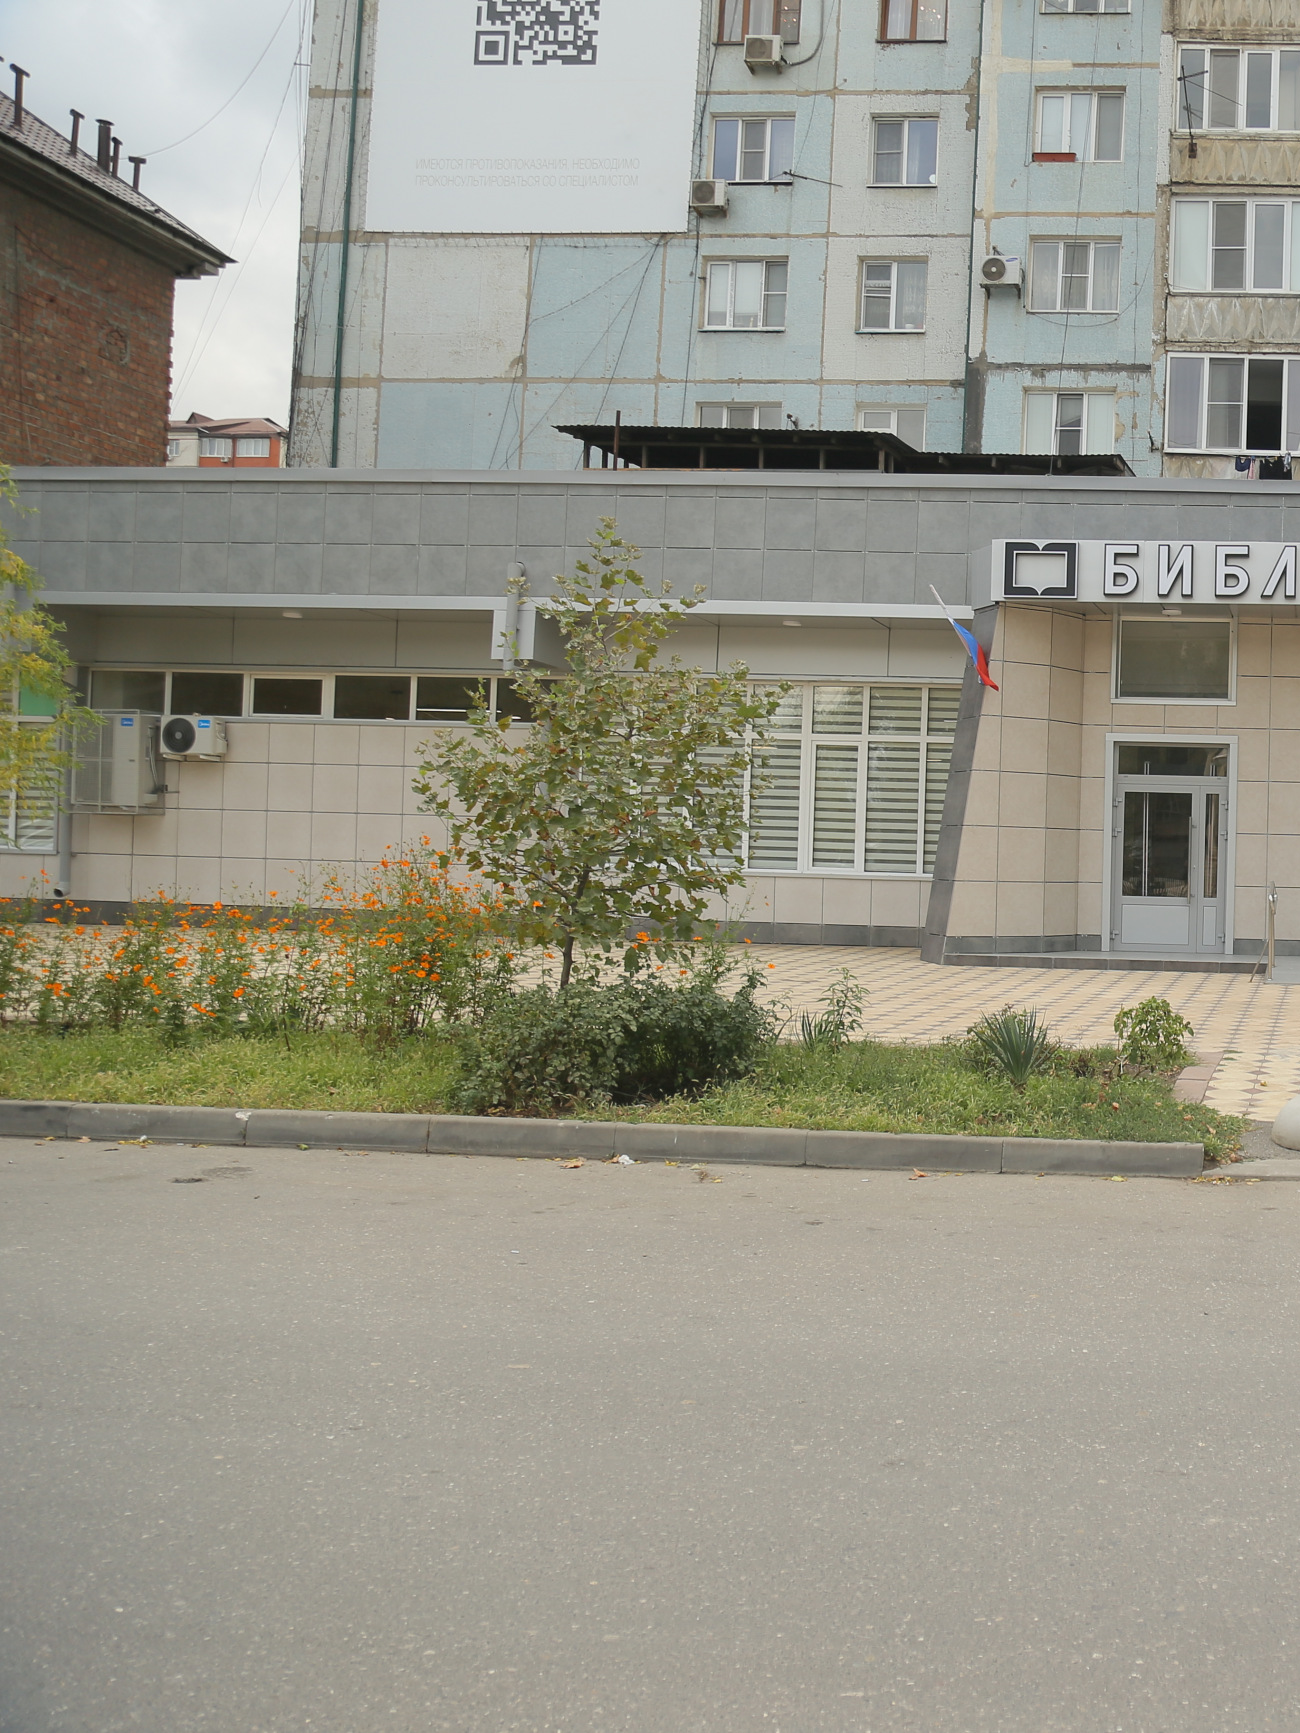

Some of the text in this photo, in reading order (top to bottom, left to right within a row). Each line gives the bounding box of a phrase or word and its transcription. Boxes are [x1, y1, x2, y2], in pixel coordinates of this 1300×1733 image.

[415, 158, 463, 170] ИМЕЮТСЯ
[572, 158, 640, 171] НЕОБХОДИМО
[415, 174, 639, 189] ПРОКОНСУЛЬТИРОВАТЬСЯ СО СПЕЦИАЛИСТОМ
